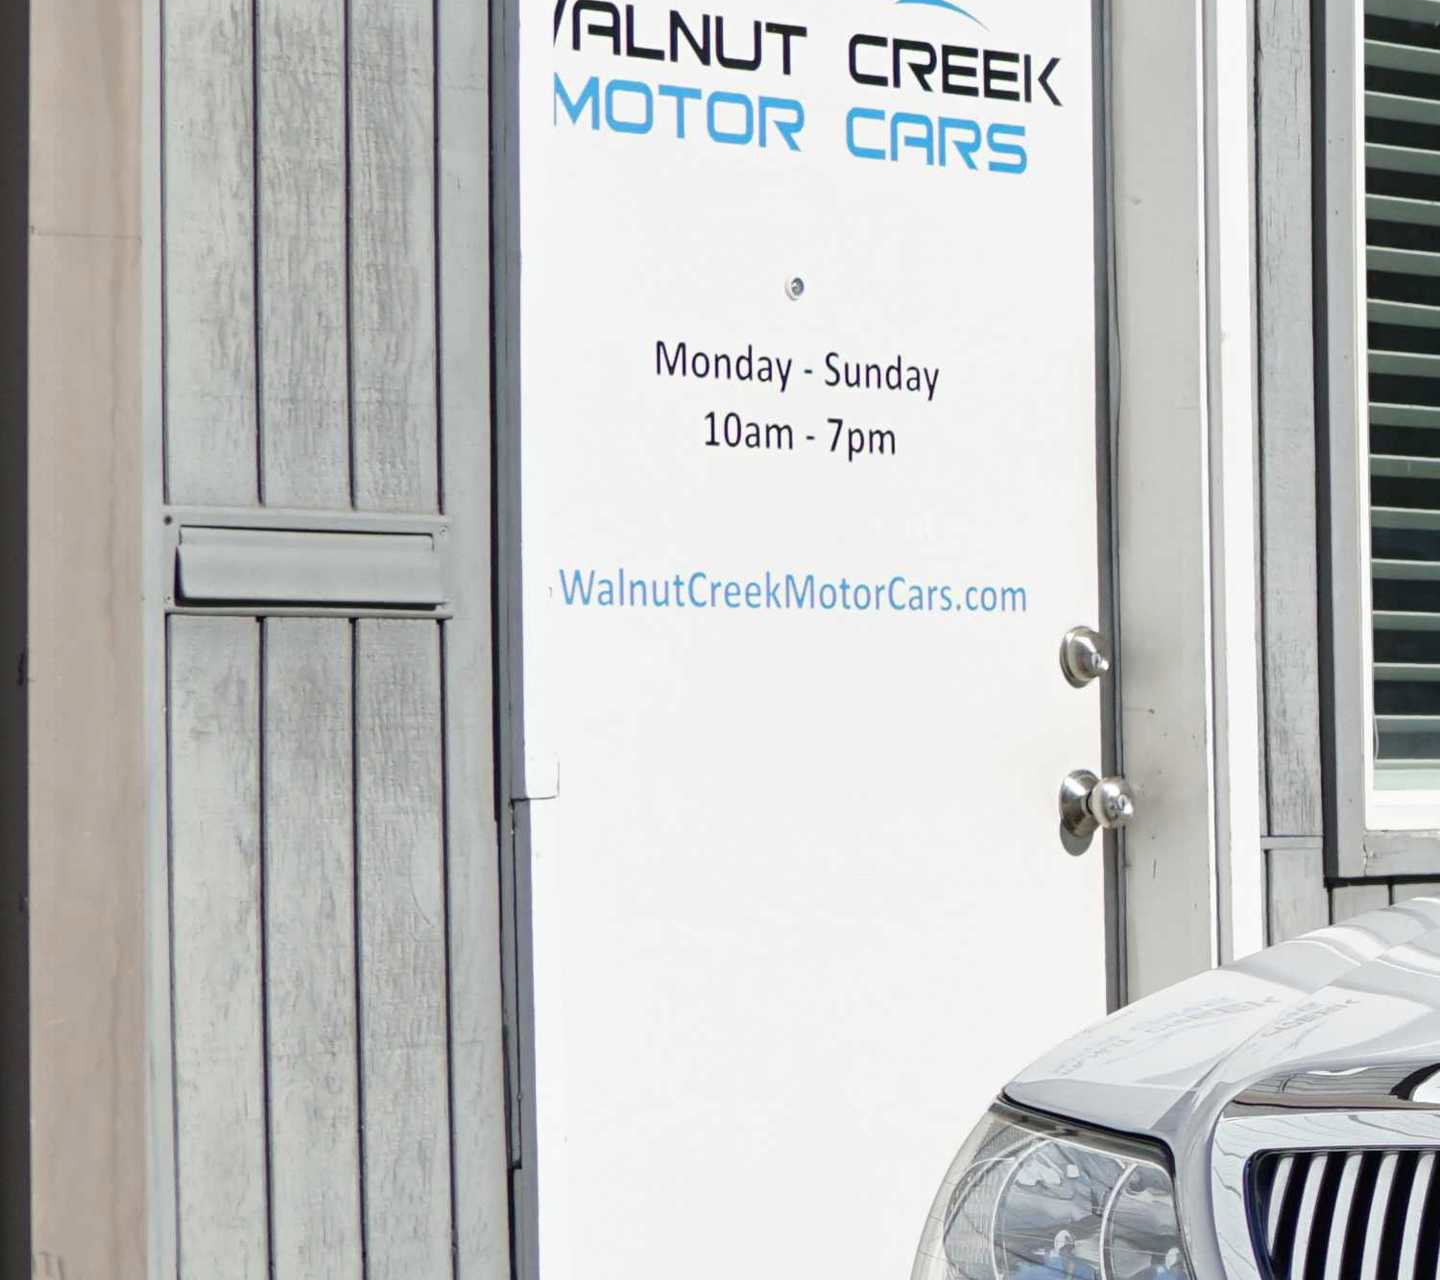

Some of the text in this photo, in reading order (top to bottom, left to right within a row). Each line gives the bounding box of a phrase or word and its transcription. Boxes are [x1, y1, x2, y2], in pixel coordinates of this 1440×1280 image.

[848, 34, 1063, 108] CREEK
[553, 72, 1028, 174] MOTOR CARS
[655, 340, 793, 393] Monday
[824, 351, 940, 401] Sunday
[704, 411, 794, 450] 10am
[826, 417, 896, 462] 7pm
[558, 568, 1027, 612] WalnutCreekMotorCars.com
